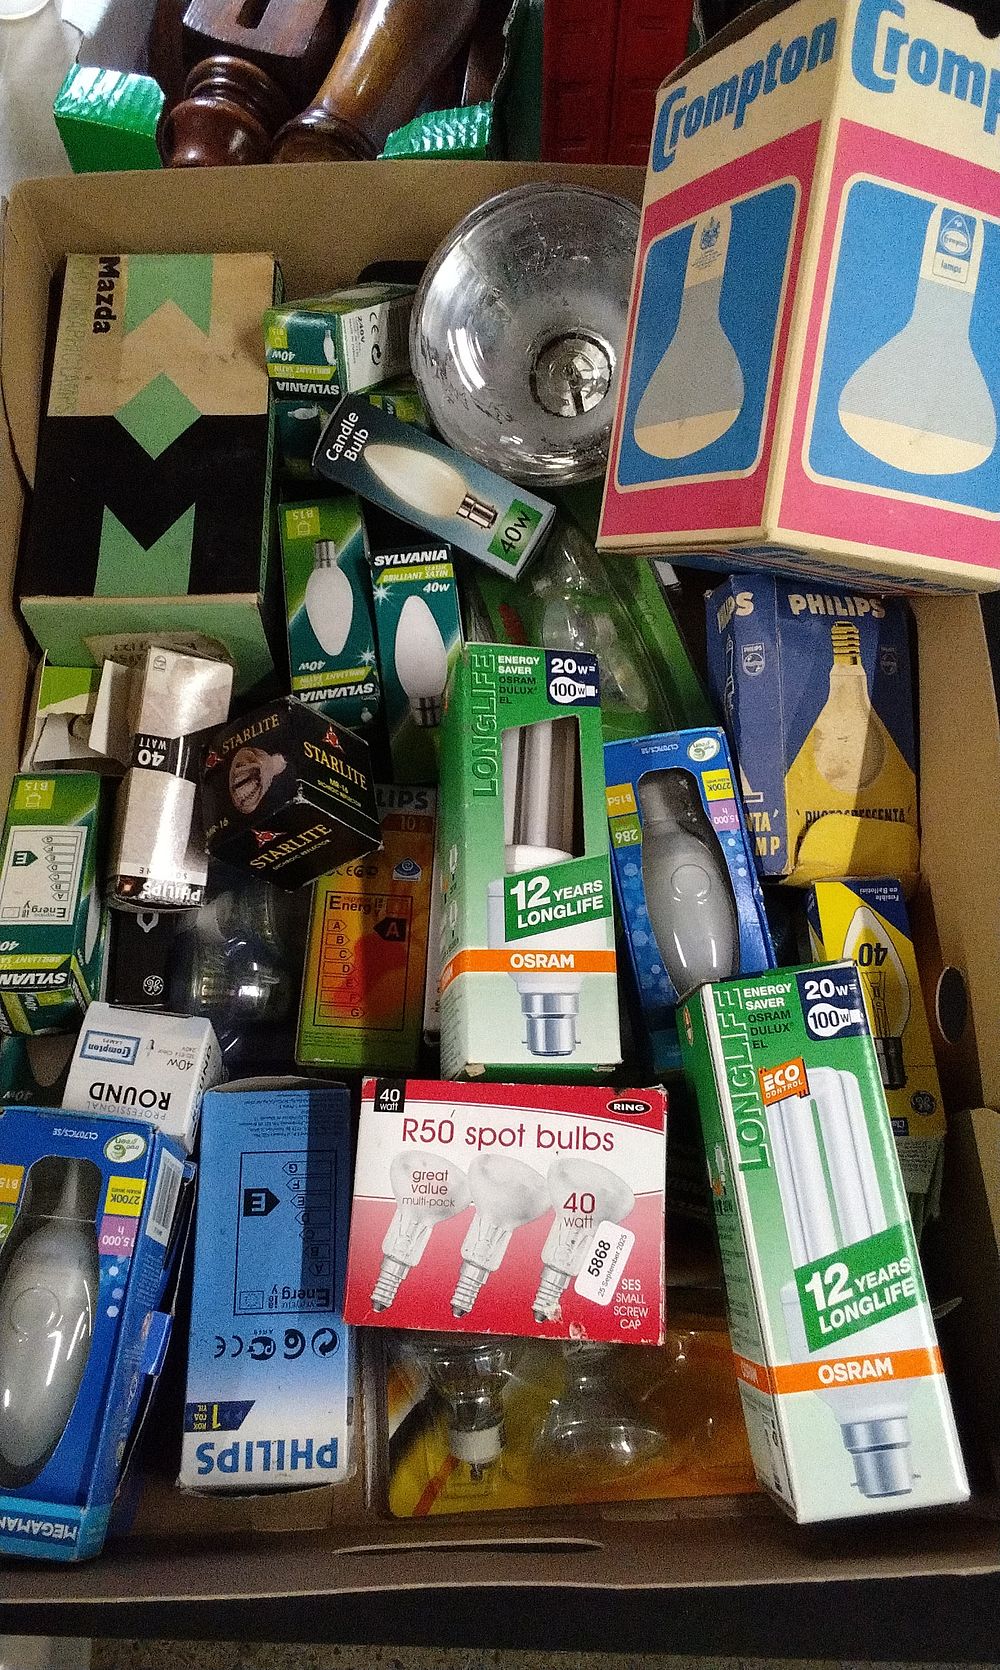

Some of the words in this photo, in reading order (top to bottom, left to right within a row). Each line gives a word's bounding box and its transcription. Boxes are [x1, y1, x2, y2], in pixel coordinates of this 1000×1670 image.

[652, 17, 837, 172] Crompton
[941, 260, 961, 273] lamps
[92, 256, 121, 334] Mazda
[277, 381, 340, 395] SYLVANIA
[326, 412, 359, 462] Candle
[344, 428, 369, 462] Bulb
[374, 549, 447, 566] SYLVANIA
[383, 571, 423, 582] BRILLIANT
[425, 569, 448, 578] SATIN
[788, 594, 886, 618] PHILIPS
[498, 655, 540, 665] ENERGY
[498, 665, 532, 675] SAVER
[499, 676, 536, 685] OSRAM
[300, 683, 374, 702] SYLVANIA
[471, 654, 499, 797] LONGLIFE
[222, 714, 280, 753] STARLITE
[139, 737, 166, 749] WATT
[138, 750, 165, 767] 40
[303, 741, 368, 790] STARLITE
[25, 782, 48, 791] B15
[707, 782, 732, 792] 2700K
[378, 790, 429, 810] LIPS
[608, 794, 632, 806] B15d
[615, 829, 638, 843] 286
[250, 824, 333, 869] STARLITE
[17, 853, 27, 863] E
[143, 881, 201, 902] PHILIPS
[511, 876, 550, 911] 12
[553, 880, 603, 901] YEARS
[517, 895, 604, 929] LONGLIFE
[332, 922, 341, 930] A
[386, 921, 400, 937] A
[336, 936, 344, 944] B
[17, 955, 62, 963] BRILLIANT
[339, 950, 348, 959] C
[510, 954, 575, 968] OSRAM
[858, 942, 888, 967] 40
[342, 965, 350, 973] D
[743, 983, 793, 998] ENERGY
[746, 998, 785, 1010] SAVER
[350, 1008, 360, 1017] G
[748, 1010, 791, 1024] OSRAM
[751, 1024, 790, 1037] DULUX
[88, 1043, 131, 1058] Crompton
[753, 1040, 768, 1049] EL
[713, 988, 772, 1171] LONGLIFE
[763, 1065, 800, 1092] ECO
[89, 1082, 172, 1110] ROUND
[379, 1088, 400, 1102] 40
[765, 1080, 803, 1099] CONTROL
[87, 1100, 167, 1121] PROFESSIONAL
[379, 1101, 399, 1111] watt
[613, 1103, 645, 1113] RING
[402, 1118, 455, 1144] R50
[464, 1123, 526, 1151] spot
[536, 1124, 615, 1151] bulbs
[289, 1163, 298, 1173] G
[412, 1169, 449, 1183] great
[292, 1180, 300, 1189] F
[411, 1182, 448, 1195] value
[111, 1194, 140, 1204] 2700K
[252, 1193, 266, 1212] E
[297, 1197, 305, 1206] E
[402, 1196, 456, 1208] multi-pack
[563, 1192, 596, 1214] 40
[564, 1215, 594, 1229] watt
[118, 1225, 124, 1234] h
[588, 1239, 611, 1277] 5868
[597, 1287, 606, 1298] 25
[602, 1250, 621, 1287] September
[617, 1234, 628, 1250] 2025
[621, 1279, 641, 1291] SES
[805, 1262, 854, 1312] 12
[855, 1257, 912, 1293] YEARS
[616, 1292, 646, 1304] SMALL
[820, 1277, 915, 1333] LONGLIFE
[613, 1306, 649, 1317] SCREW
[620, 1318, 642, 1329] CAP
[818, 1358, 894, 1384] OSRAM
[212, 1405, 221, 1429] 1
[195, 1438, 338, 1475] PHILIPS
